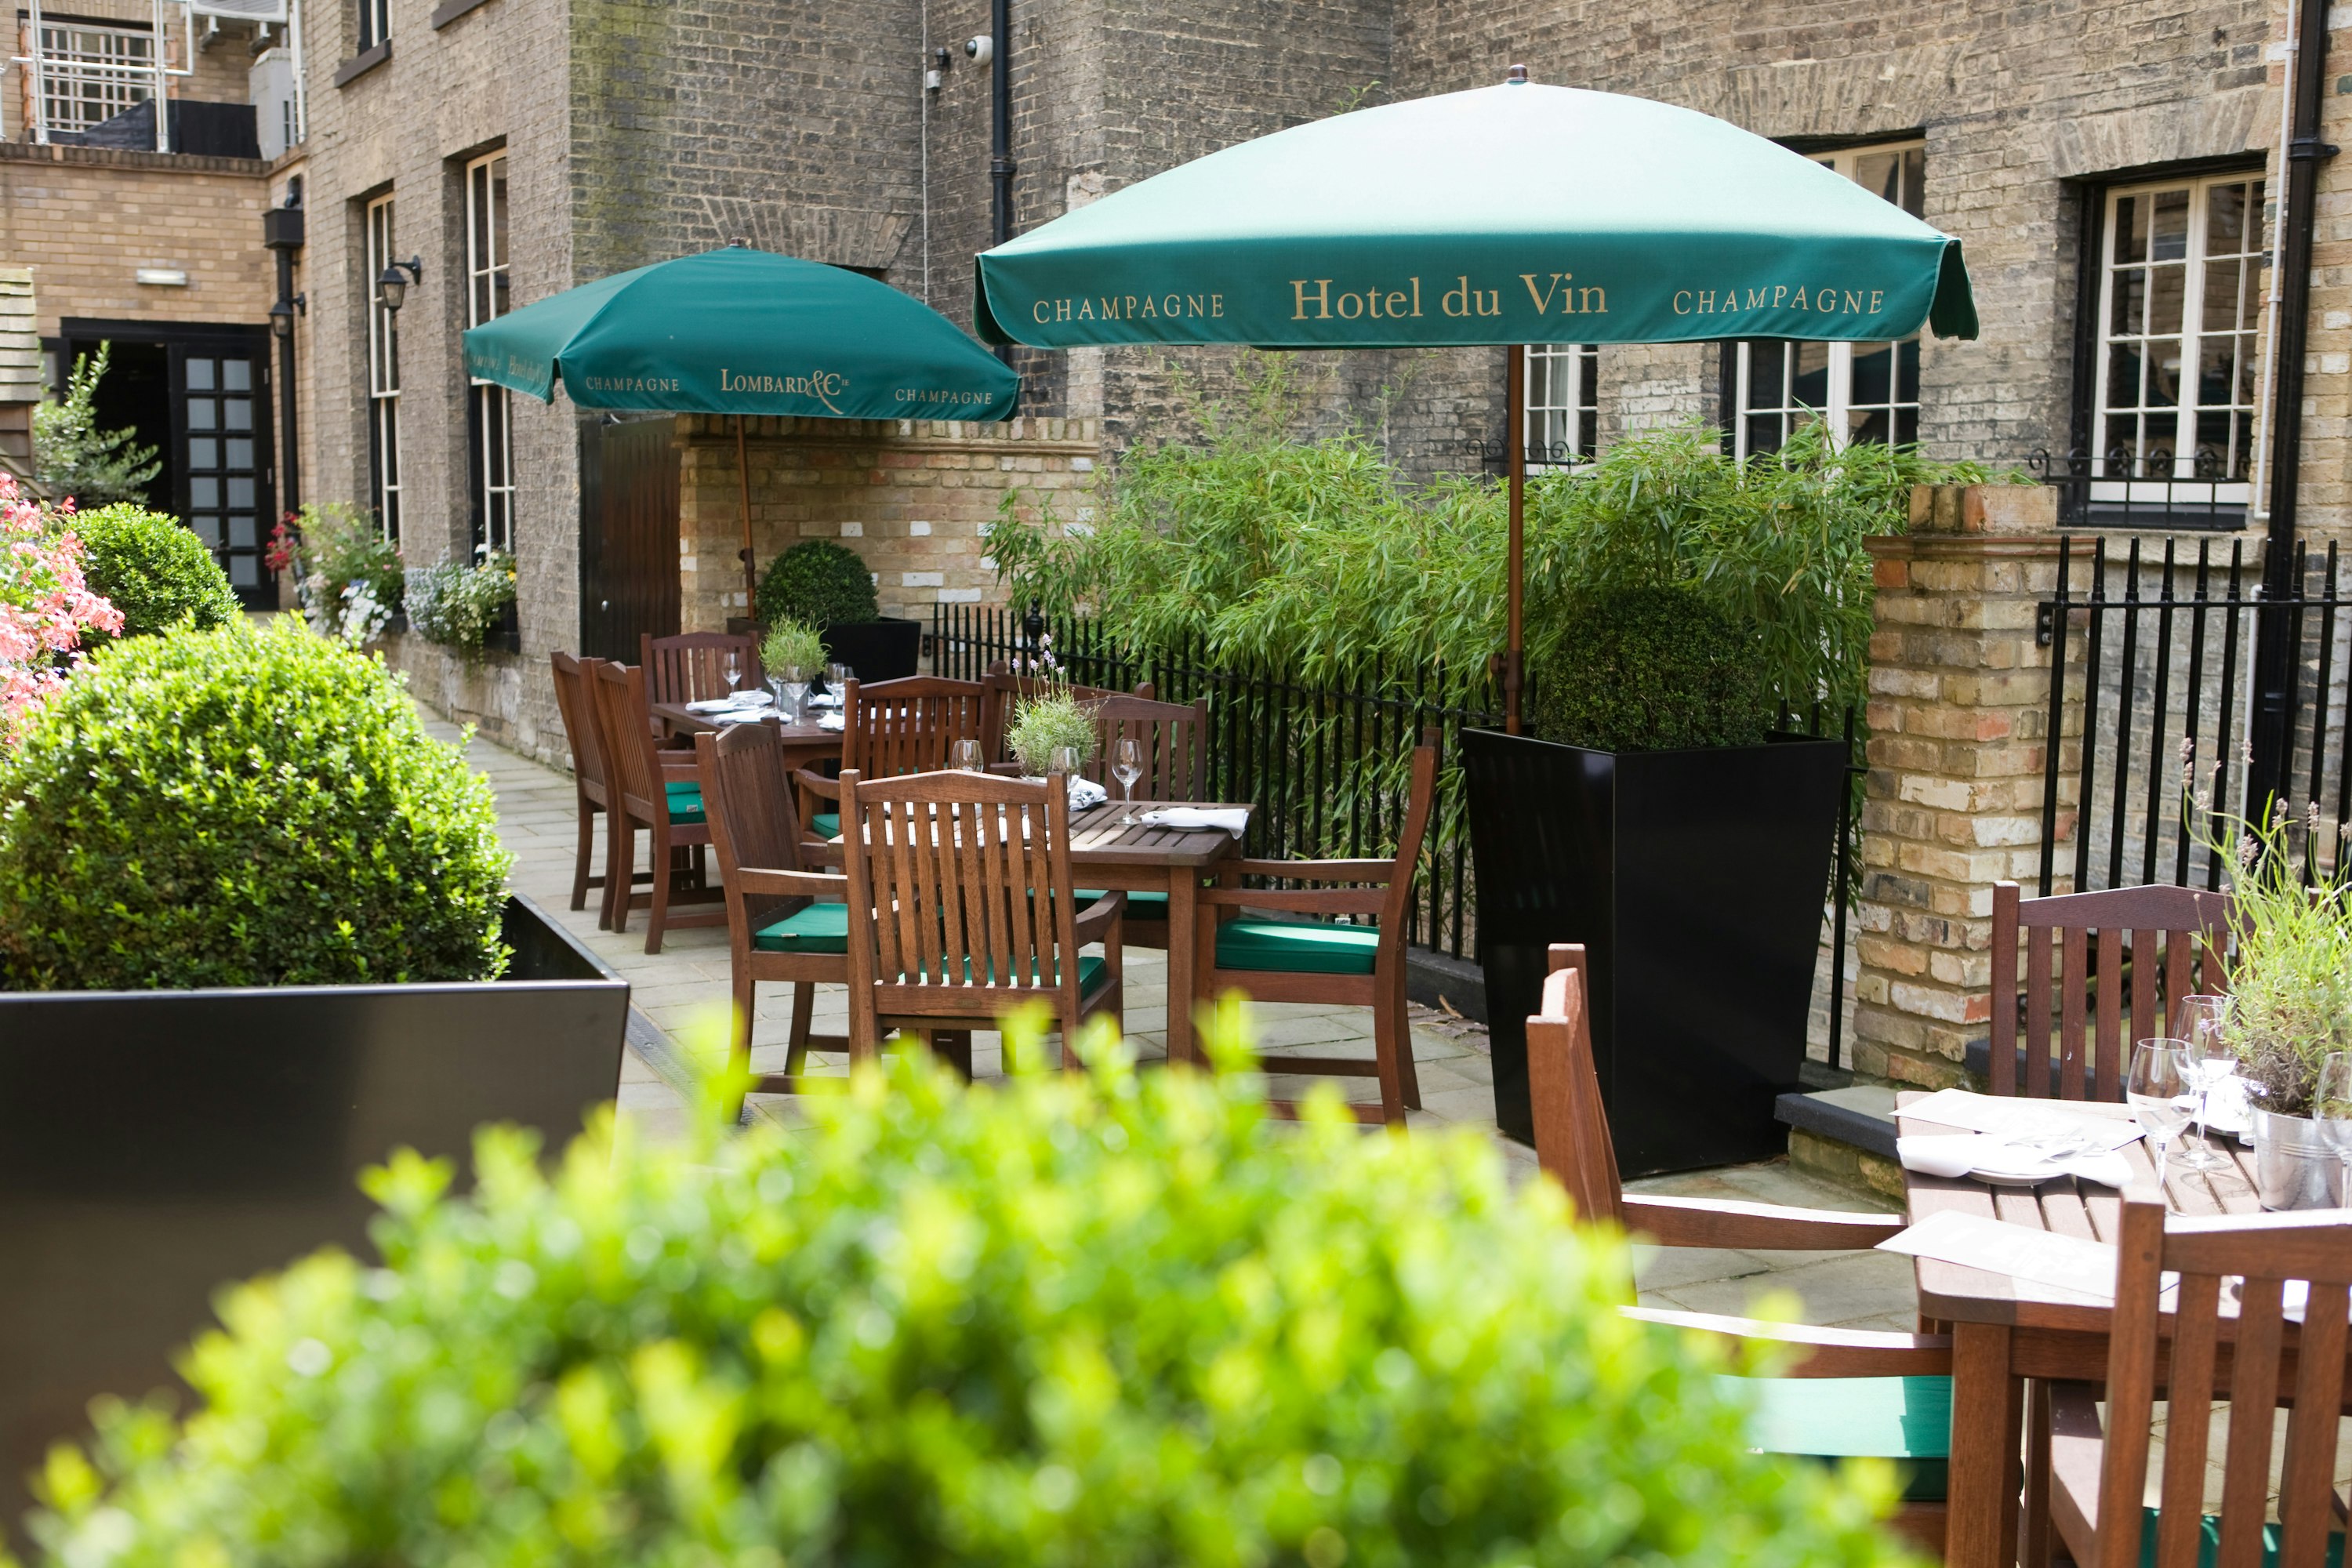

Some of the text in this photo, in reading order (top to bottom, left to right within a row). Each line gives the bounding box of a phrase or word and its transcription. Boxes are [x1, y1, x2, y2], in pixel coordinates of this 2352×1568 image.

[1033, 272, 1884, 324] CHAMPAGNE Hotel du Vin CHAMPAGNE
[586, 376, 680, 392] CHAMPAGNE
[895, 389, 993, 405] CHAMPAGNE
